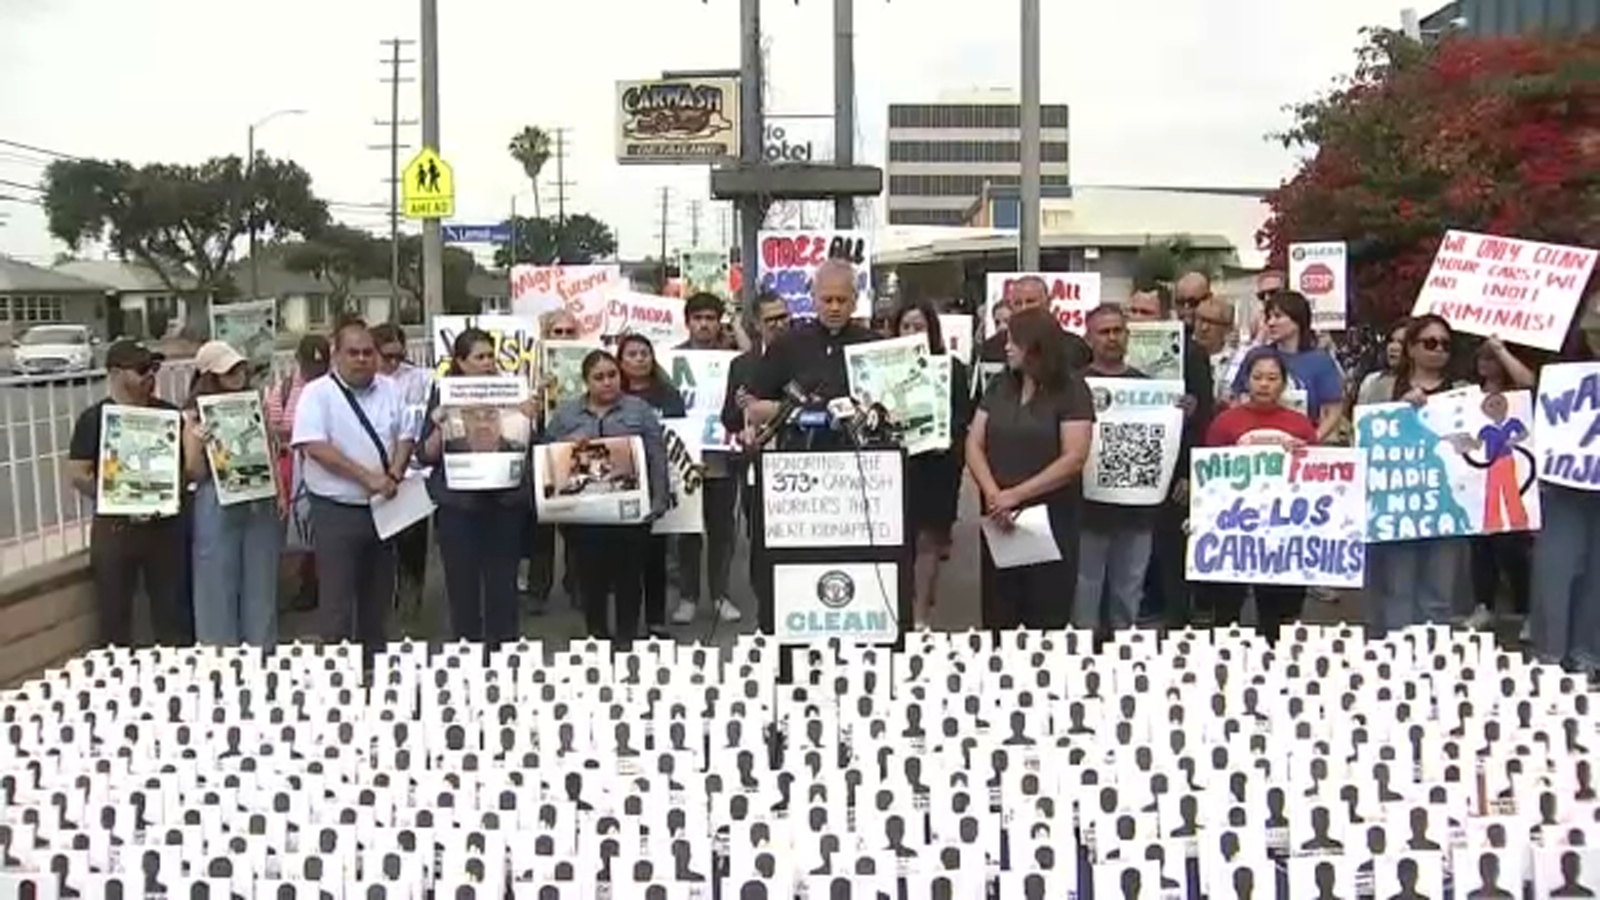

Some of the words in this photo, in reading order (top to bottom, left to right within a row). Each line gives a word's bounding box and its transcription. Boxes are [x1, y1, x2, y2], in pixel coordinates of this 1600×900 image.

[622, 83, 723, 113] CARWASH
[410, 201, 450, 214] AHEAD
[827, 235, 865, 265] ALL
[1444, 234, 1469, 254] WE
[1476, 236, 1523, 263] ONLY
[1532, 245, 1591, 271] CLEAN
[1302, 274, 1333, 289] STOP
[1429, 275, 1458, 291] ARE
[1436, 255, 1481, 275] YOUR
[1545, 271, 1577, 290] WE
[1429, 300, 1556, 332] CRIMINALS!
[1114, 389, 1178, 406] CLEAN
[1370, 417, 1401, 439] DE
[765, 454, 847, 471] HONORING
[852, 454, 881, 471] THE
[1194, 451, 1286, 491] Migra
[1287, 449, 1356, 485] Fuera
[822, 475, 894, 491] CARWASH
[768, 497, 842, 516] WORKERS
[850, 497, 881, 514] THAT
[1387, 489, 1441, 513] NOS
[1216, 497, 1260, 533] de
[1269, 494, 1334, 526] LOS
[767, 521, 806, 539] WERE
[811, 520, 891, 539] KIDNAPPED
[1374, 512, 1456, 541] SACA
[1193, 532, 1364, 575] CARWASHES
[785, 611, 888, 632] CLEAN
